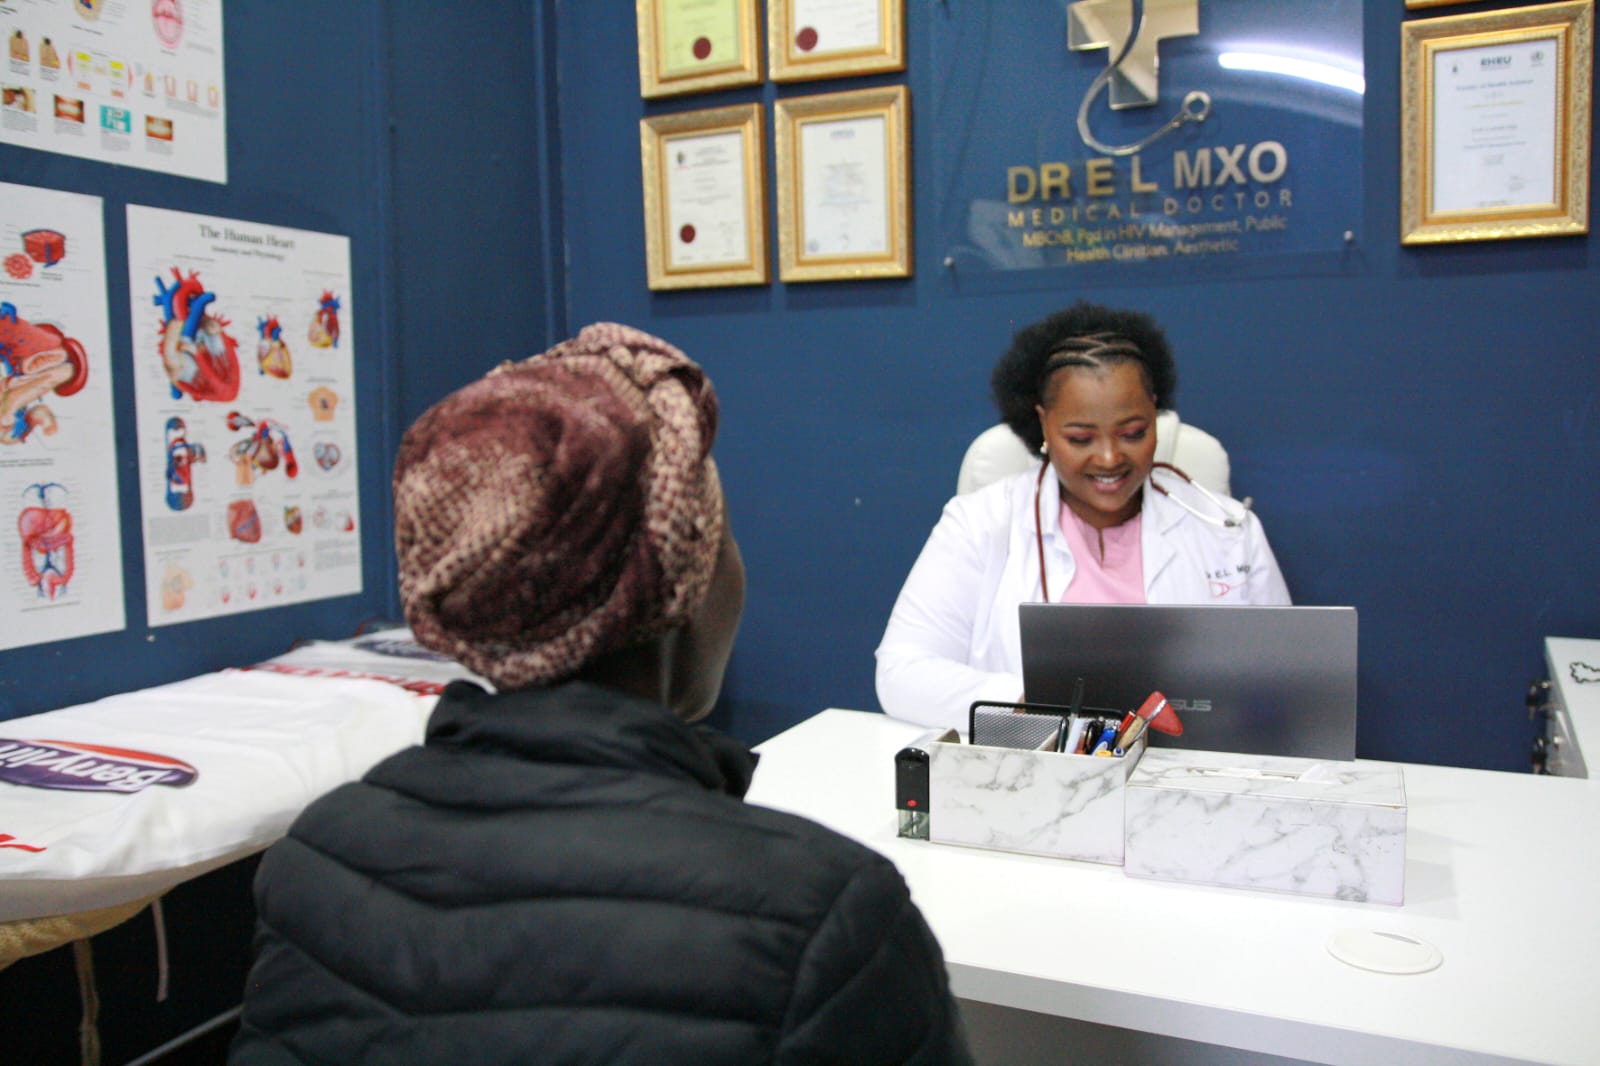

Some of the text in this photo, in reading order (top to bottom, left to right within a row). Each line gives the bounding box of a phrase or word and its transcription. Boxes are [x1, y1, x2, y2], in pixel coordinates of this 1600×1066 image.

[1007, 140, 1288, 204] DR E L MXO
[1007, 188, 1293, 228] MEDICAL DOCTOR
[198, 223, 295, 249] The Human Heart
[1119, 222, 1147, 240] HIV
[1245, 215, 1288, 231] Public
[1167, 699, 1213, 712] SUS
